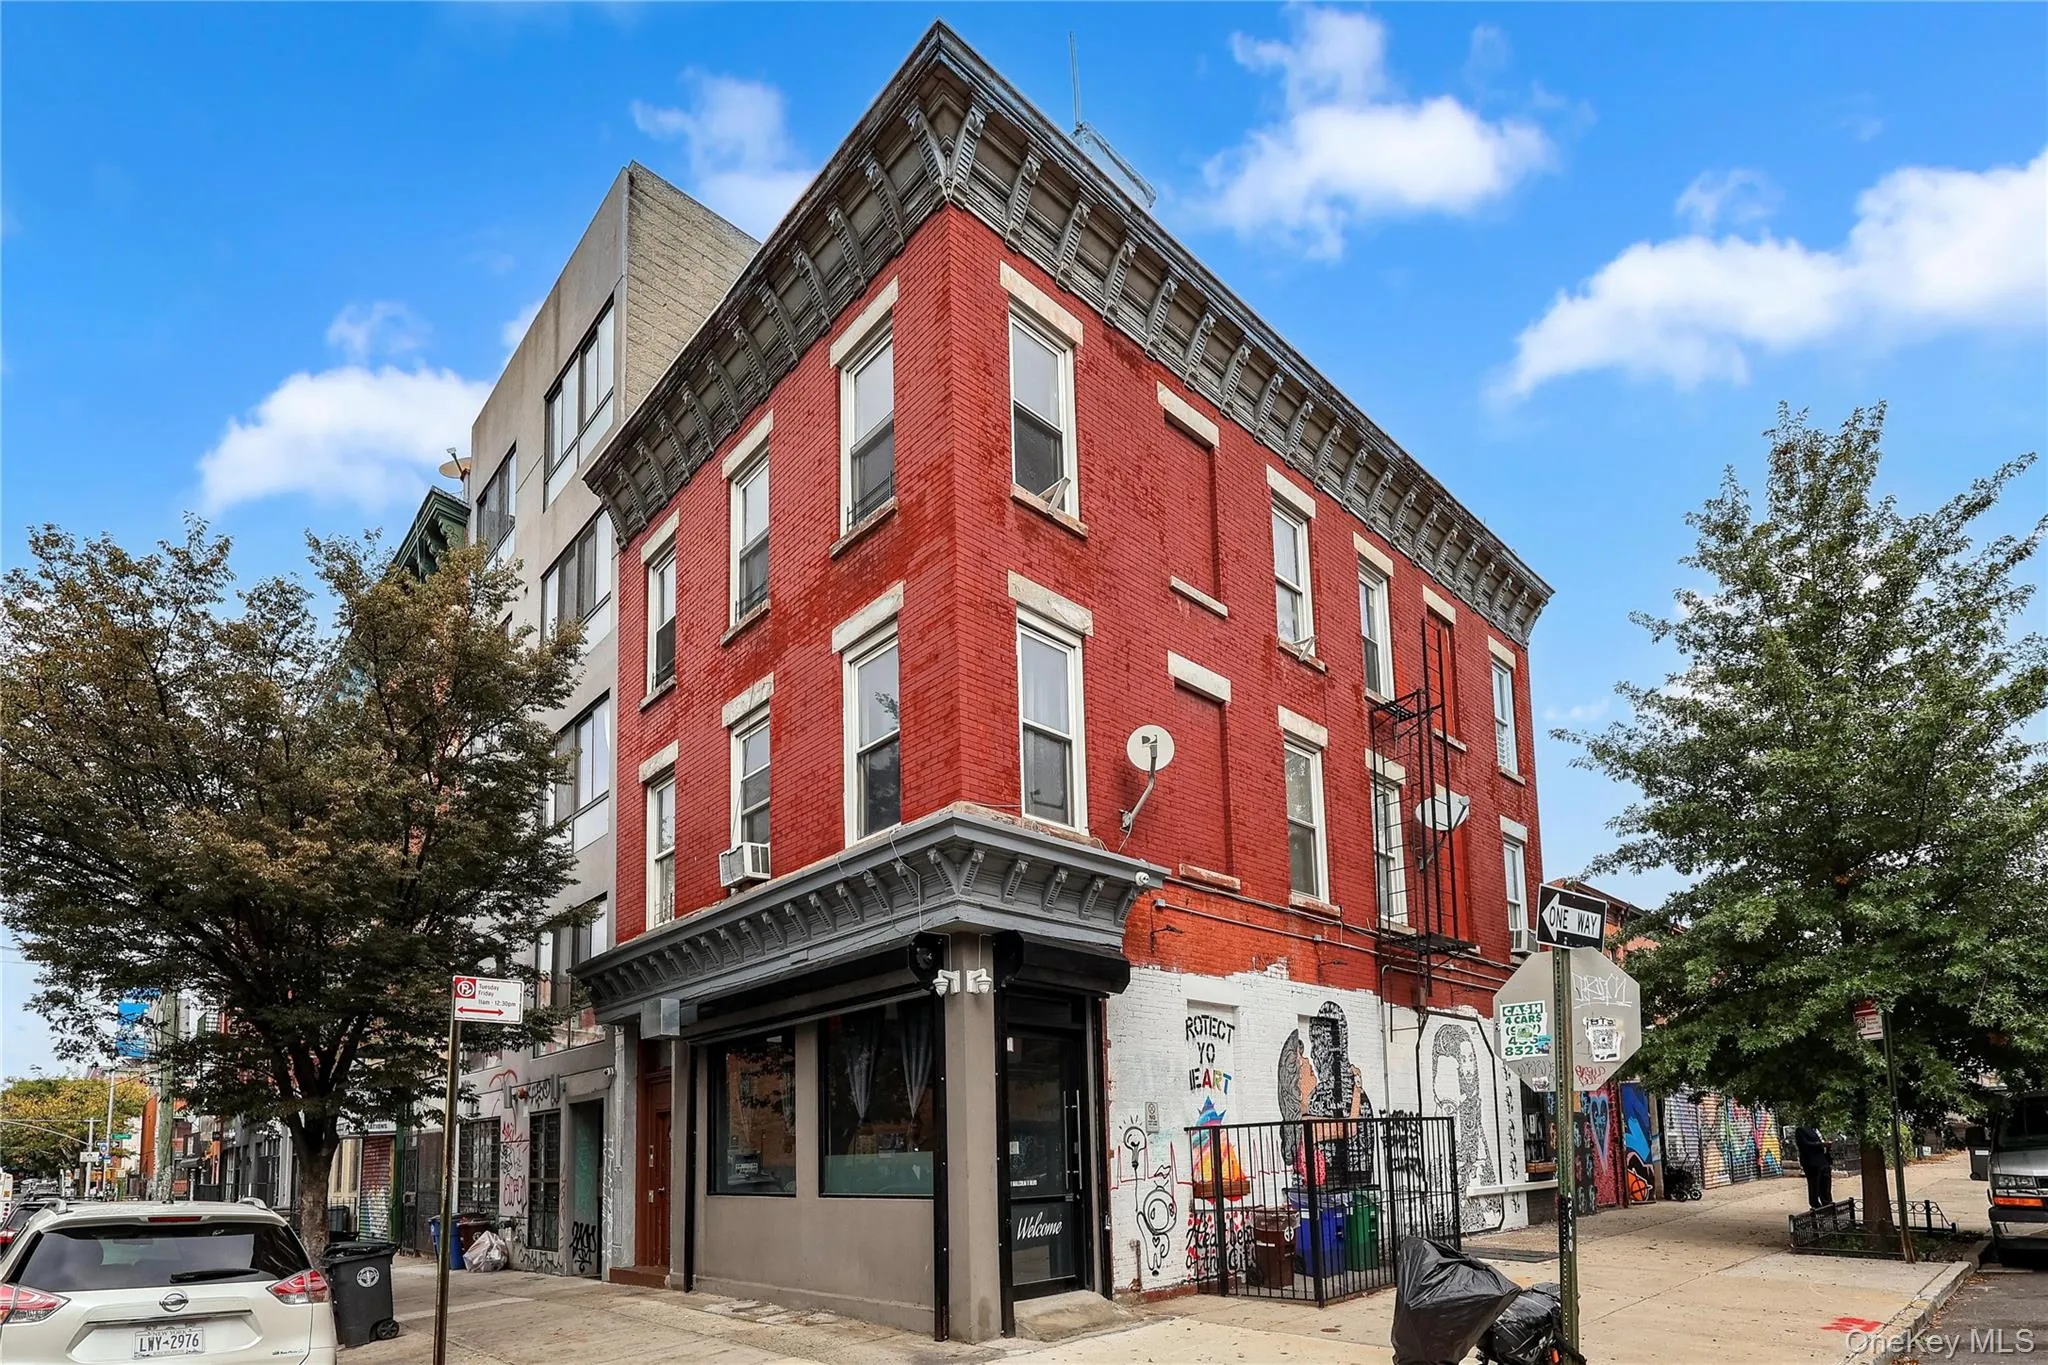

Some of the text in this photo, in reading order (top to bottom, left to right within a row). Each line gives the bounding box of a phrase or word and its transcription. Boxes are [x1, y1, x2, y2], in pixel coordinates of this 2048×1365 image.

[1549, 906, 1597, 936] ONE WAY
[478, 990, 494, 998] Friday
[1505, 1017, 1512, 1025] 4
[1197, 1042, 1215, 1064] YO
[1017, 1211, 1062, 1240] Welcome
